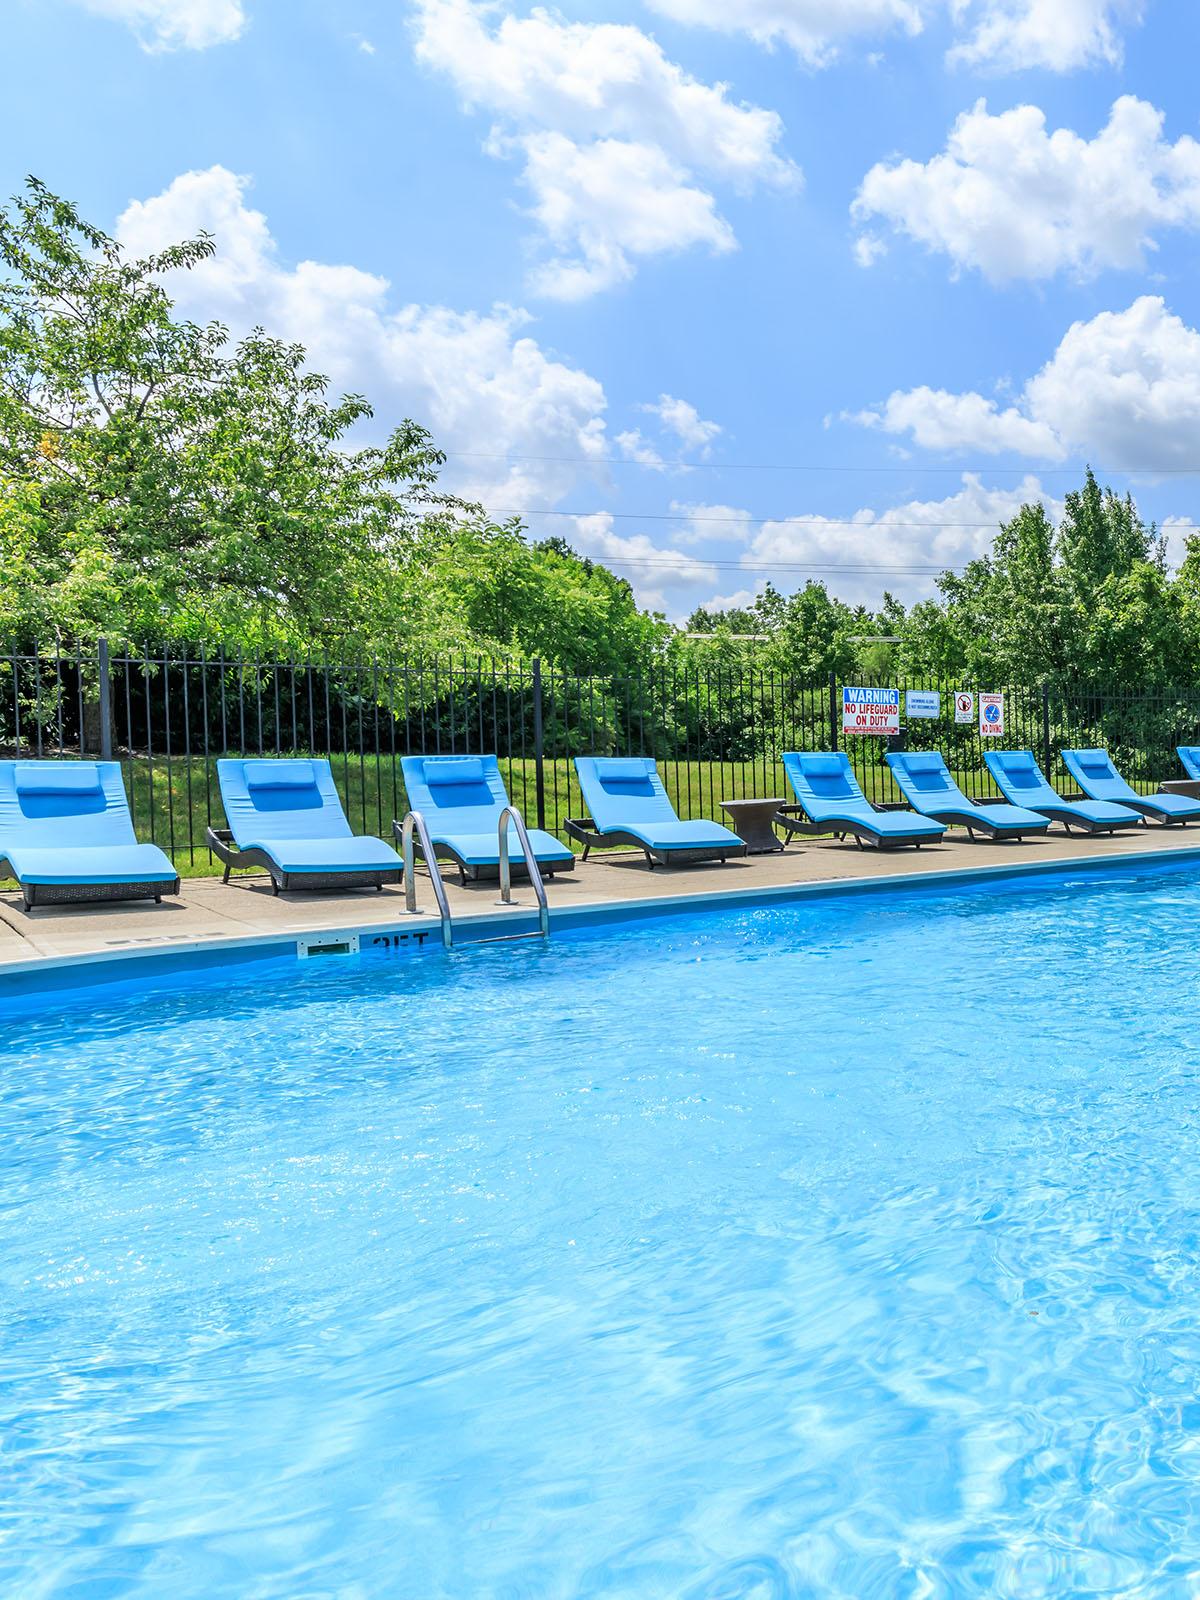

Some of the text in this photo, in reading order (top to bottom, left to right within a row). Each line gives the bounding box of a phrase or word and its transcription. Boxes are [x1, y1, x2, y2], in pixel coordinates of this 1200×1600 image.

[848, 689, 896, 703] WARNING
[845, 704, 856, 714] NO
[859, 704, 897, 715] LIFEGUARD
[856, 715, 888, 726] ON DUTY
[982, 724, 988, 733] NO
